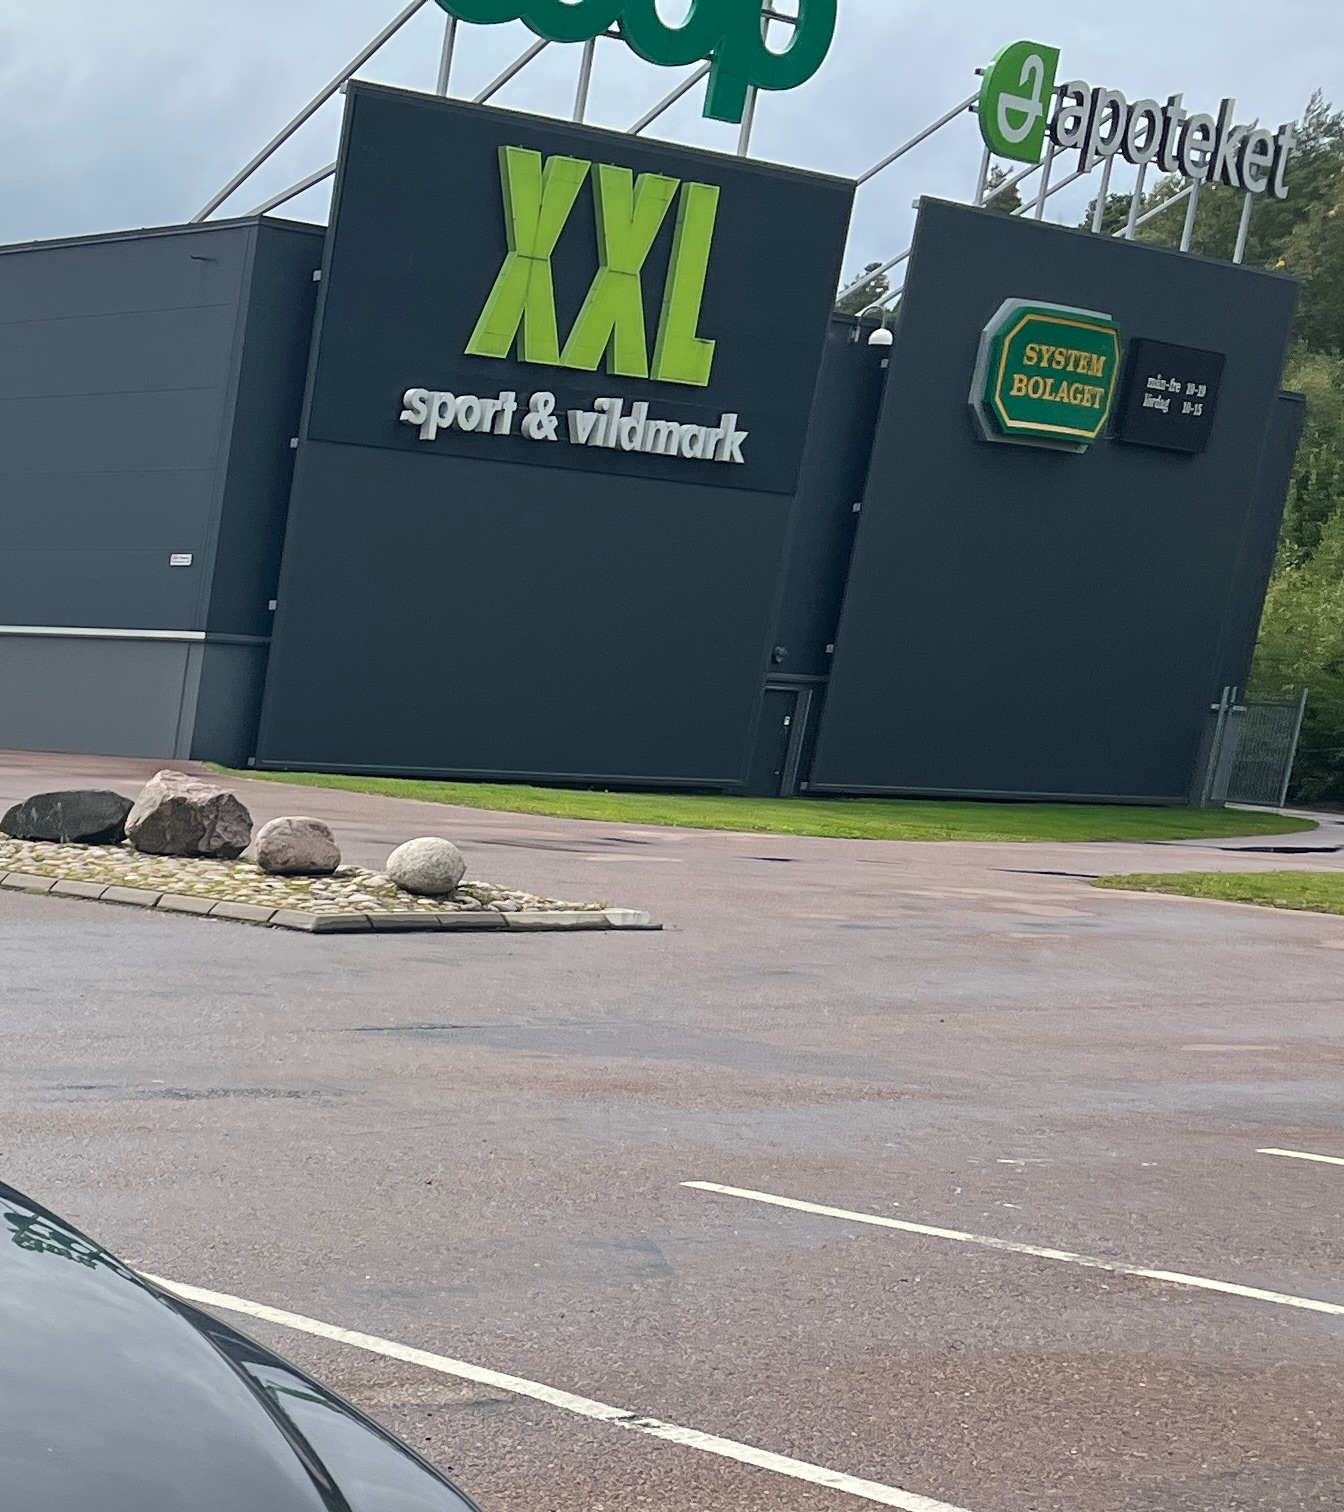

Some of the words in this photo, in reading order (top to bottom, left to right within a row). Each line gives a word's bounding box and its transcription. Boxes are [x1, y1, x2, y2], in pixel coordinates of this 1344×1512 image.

[1050, 80, 1298, 200] apoteket
[464, 145, 720, 387] XXL
[1009, 373, 1105, 409] BOLAGET
[1023, 343, 1107, 378] SYSTEM
[400, 388, 516, 441] sport
[522, 391, 558, 442] &
[568, 398, 749, 464] vildmark
